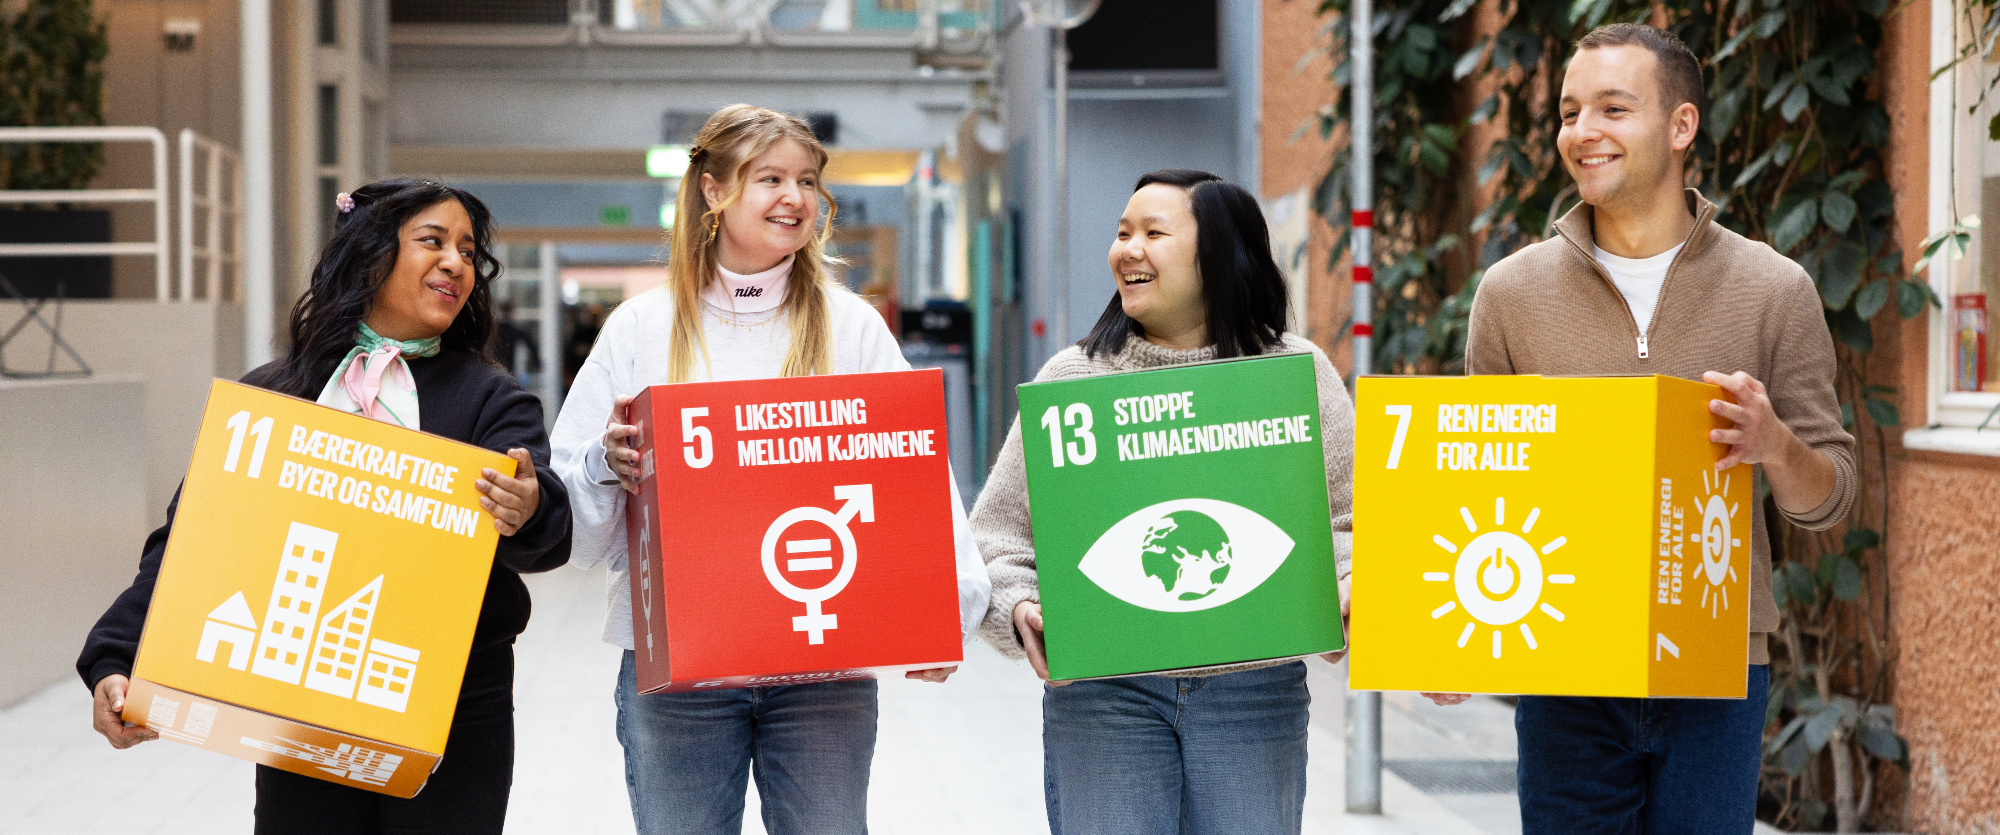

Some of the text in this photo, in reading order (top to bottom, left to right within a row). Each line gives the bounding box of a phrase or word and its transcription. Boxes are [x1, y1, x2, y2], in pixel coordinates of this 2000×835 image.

[734, 285, 764, 298] nike
[735, 397, 867, 431] LIKESTILLING
[1041, 402, 1097, 468] 13
[1113, 391, 1196, 426] STOPPE
[1437, 404, 1557, 433] REN ENERGI
[223, 410, 275, 479] 11
[287, 424, 459, 494] BÆREKRAFTIGE
[680, 406, 714, 469] 5
[737, 429, 936, 467] MELLOM KJØNNENE
[1117, 415, 1313, 462] KLIMAENDRINGENE
[1385, 404, 1412, 470] 7
[1436, 442, 1530, 471] FOR ALLE
[278, 459, 480, 538] BYER OG SAMFUNN
[1657, 477, 1673, 604] REN ENERGI
[1671, 506, 1684, 605] FOR ALLE
[1655, 632, 1680, 662] 7
